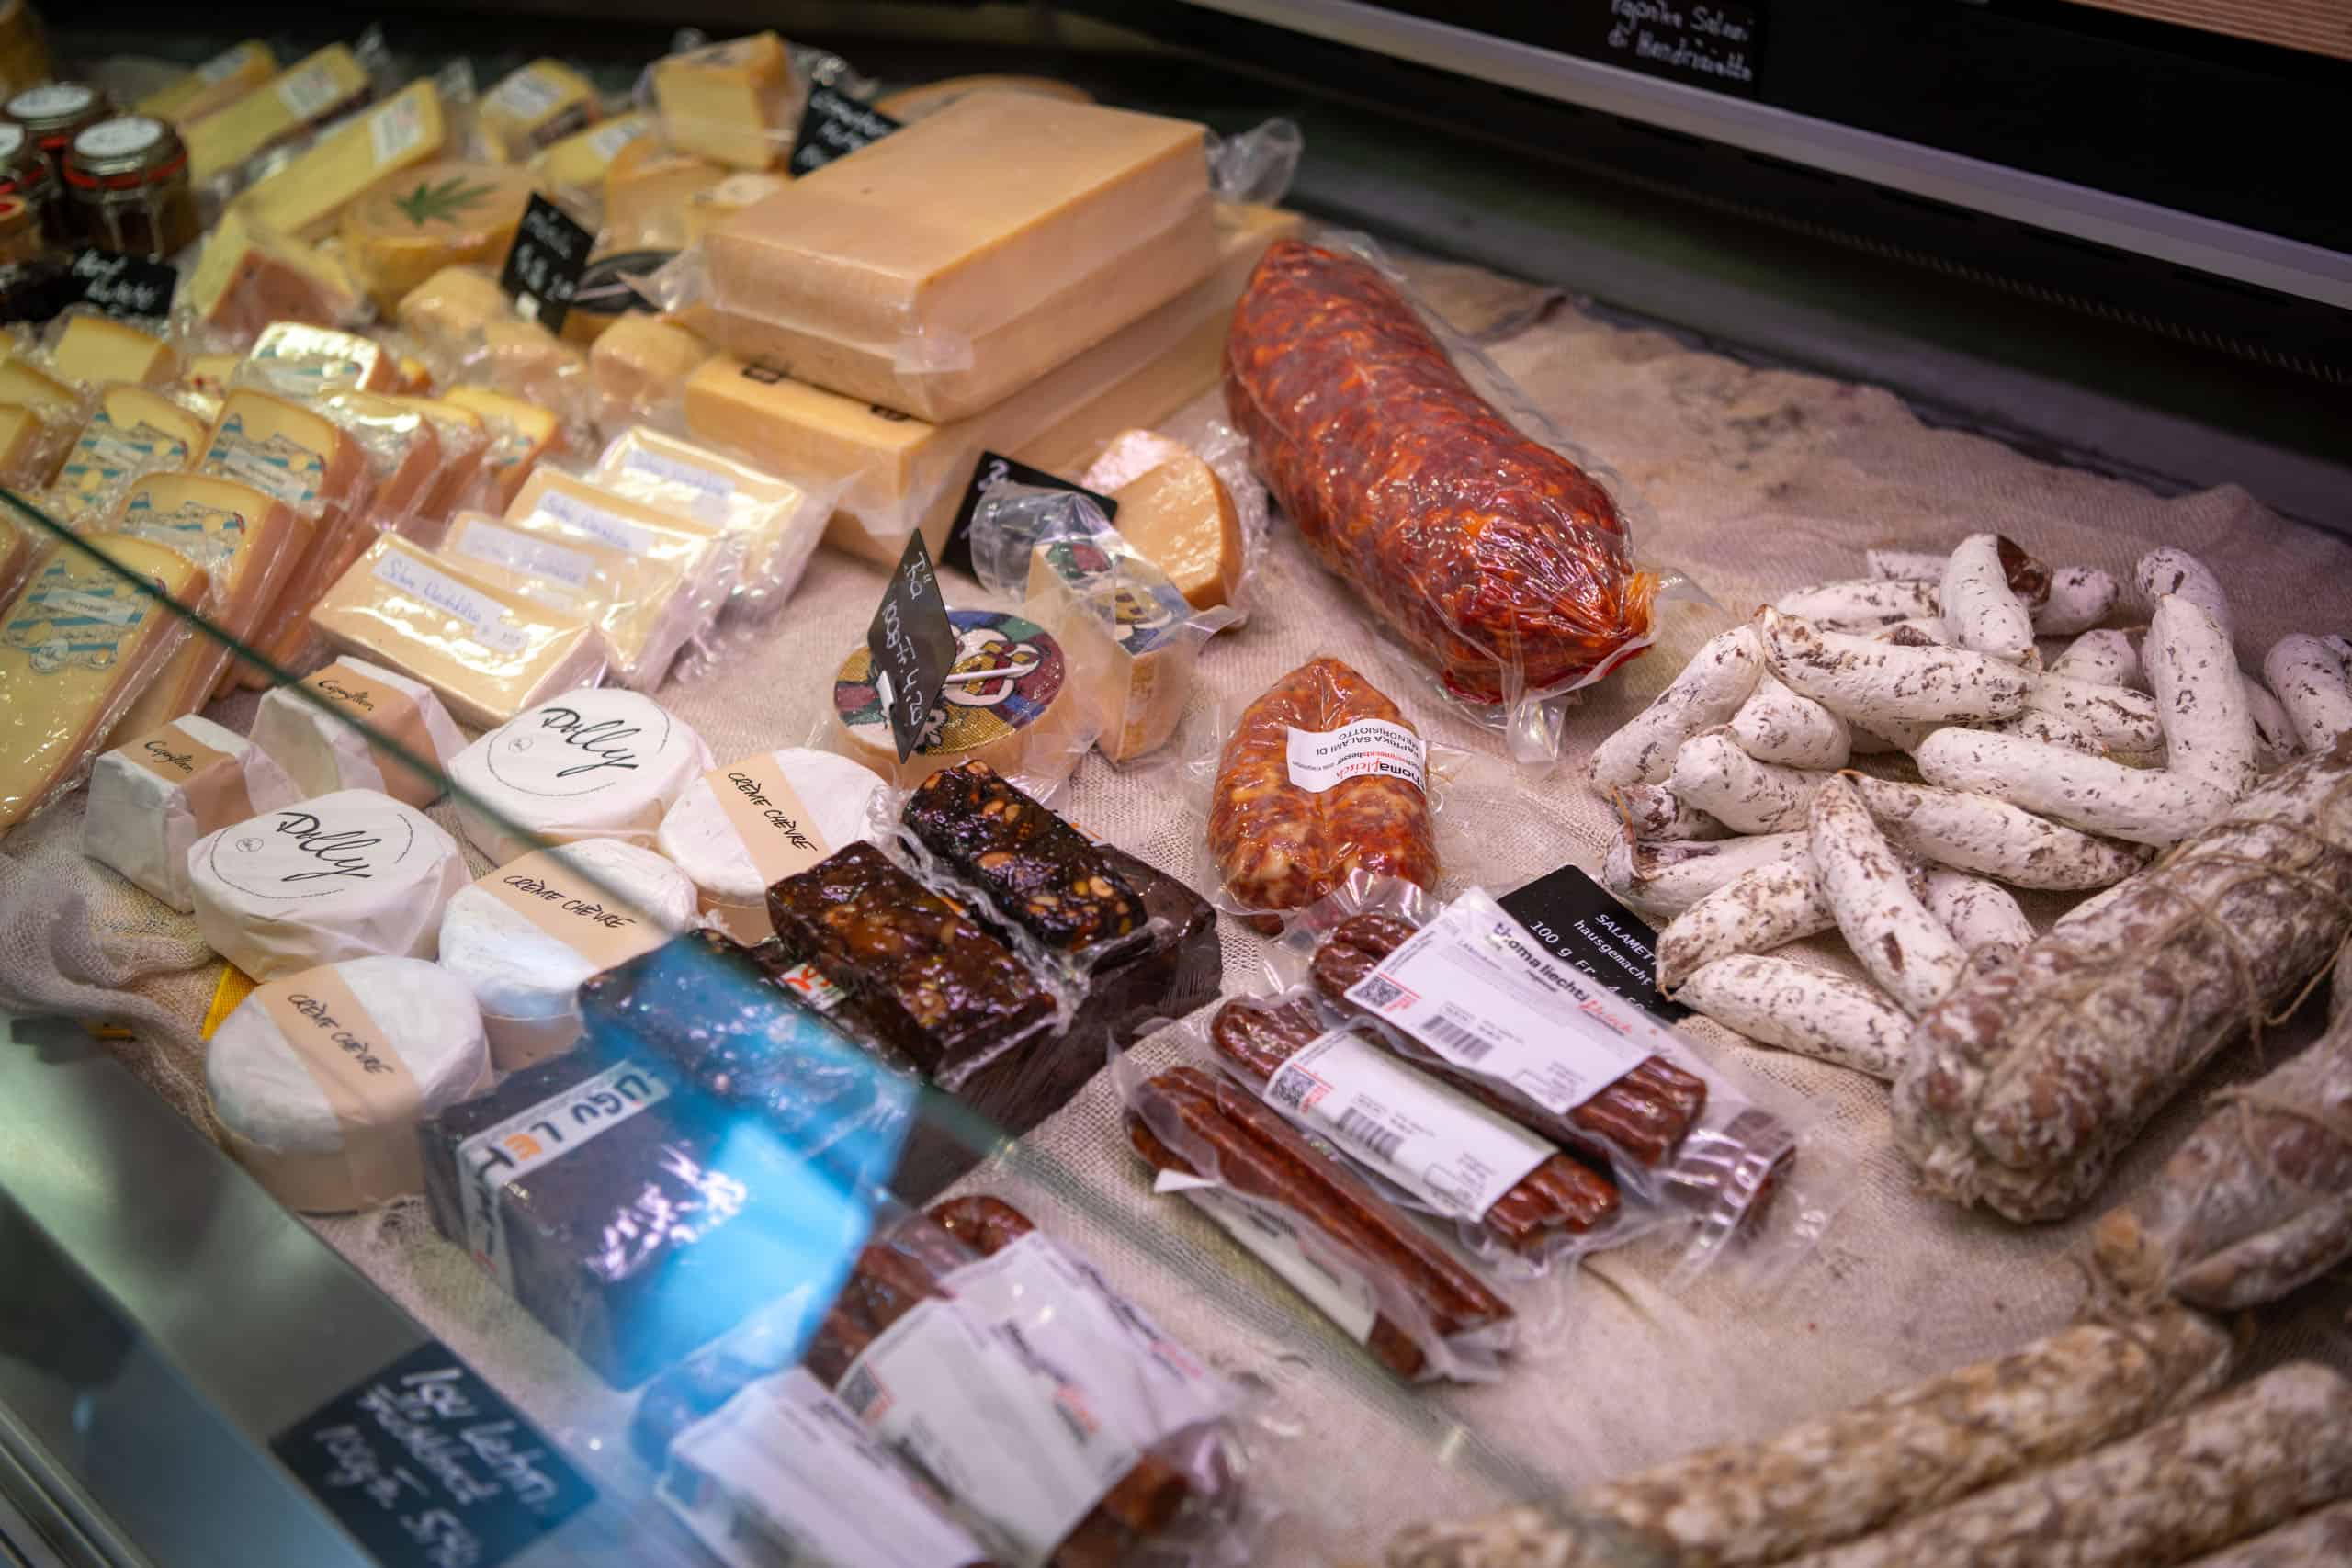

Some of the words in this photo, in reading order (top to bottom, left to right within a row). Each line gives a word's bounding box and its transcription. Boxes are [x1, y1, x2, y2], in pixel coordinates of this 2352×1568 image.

[1316, 744, 1329, 756] DI
[1331, 736, 1372, 753] SALAMI
[1530, 920, 1559, 943] 100
[1558, 947, 1573, 958] g
[1574, 919, 1654, 986] hausgemacht
[1595, 913, 1656, 966] SALAMET
